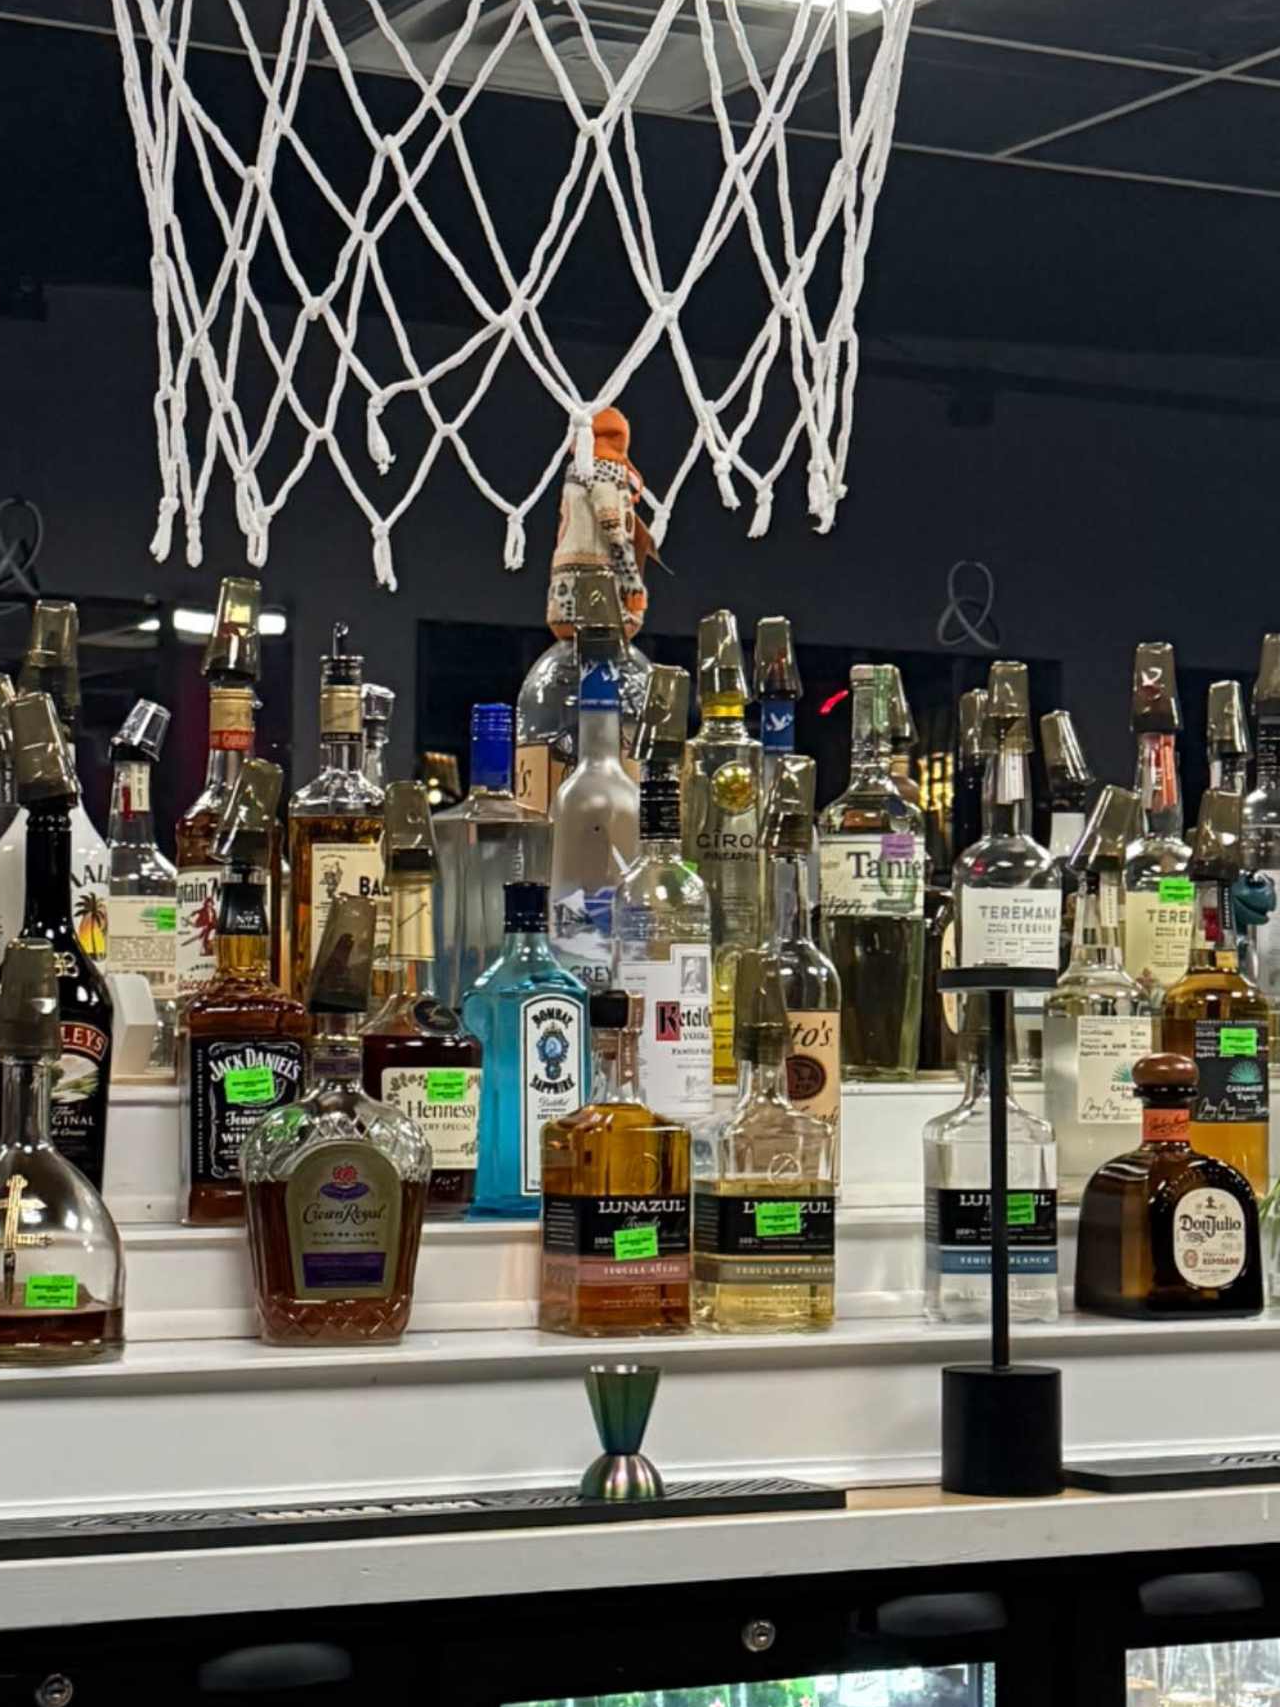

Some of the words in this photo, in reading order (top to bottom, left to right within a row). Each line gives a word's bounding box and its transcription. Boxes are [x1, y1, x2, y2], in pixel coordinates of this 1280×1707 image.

[847, 851, 922, 880] Tante
[531, 1007, 574, 1029] BOMBAY
[528, 1073, 576, 1095] SAPPHIRE
[597, 1199, 686, 1214] LUNAZUL
